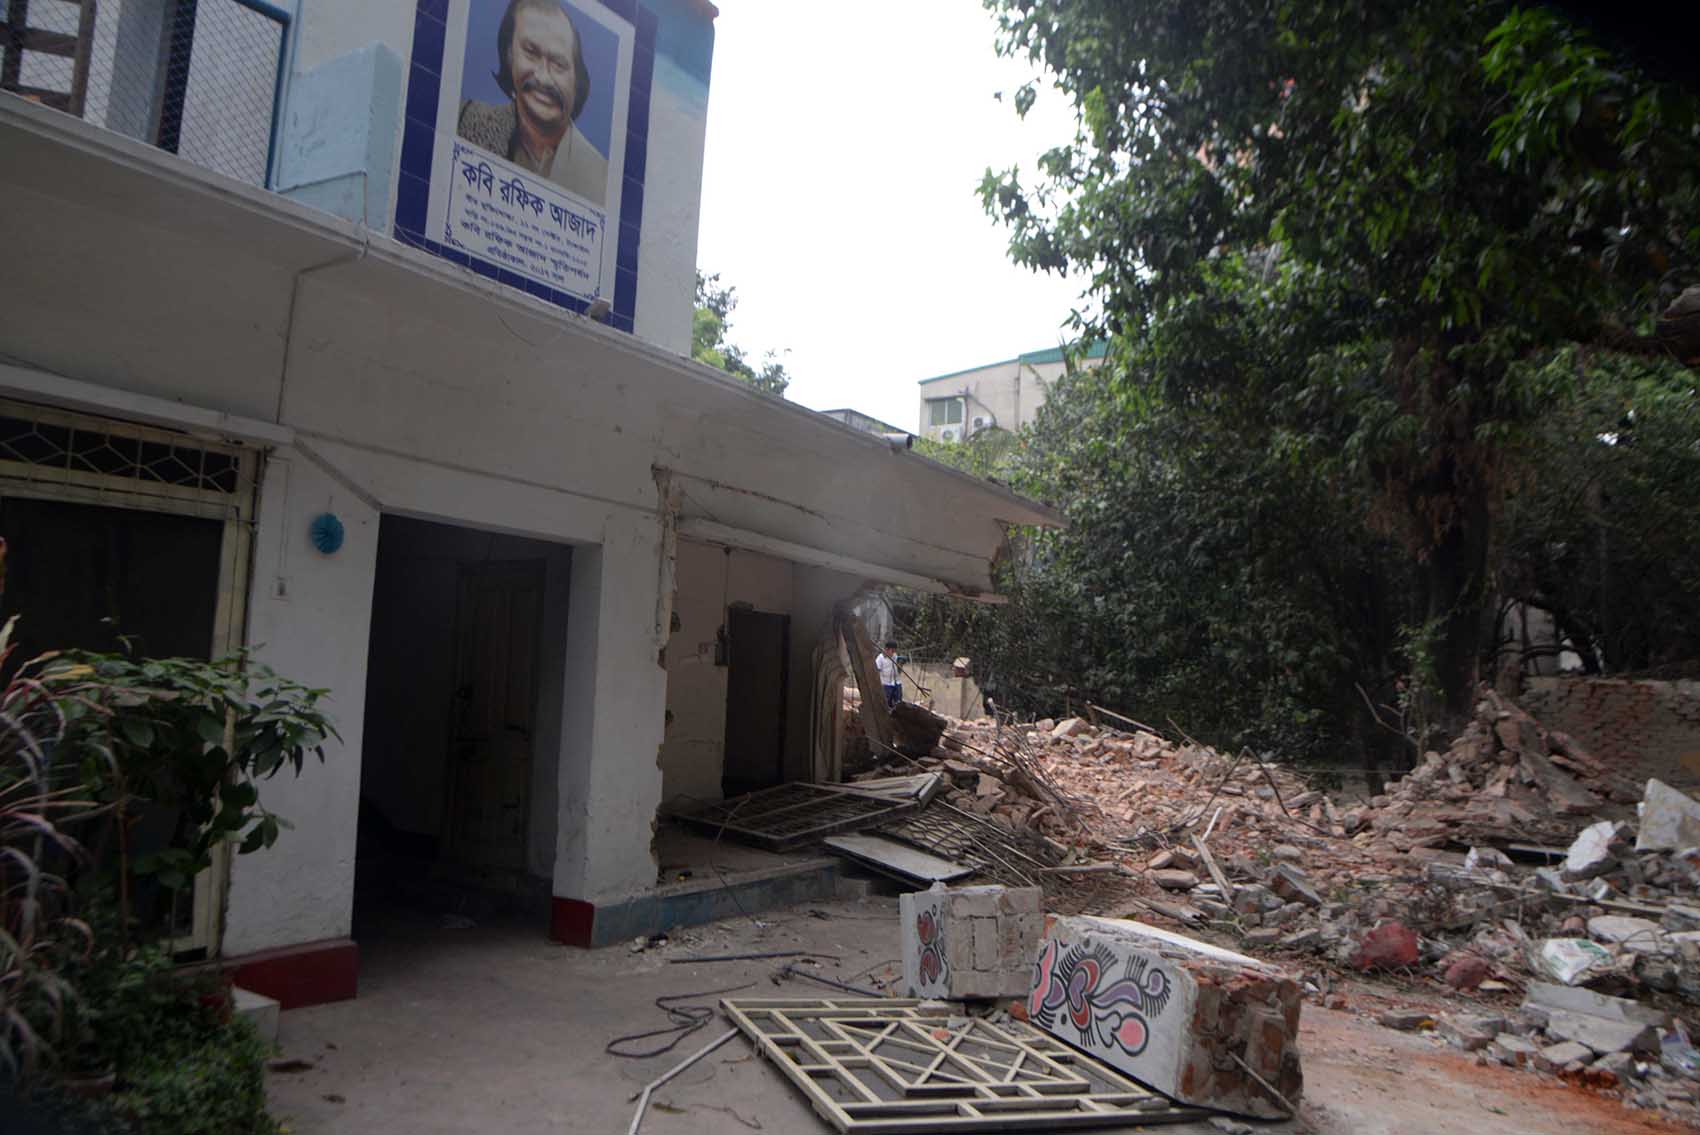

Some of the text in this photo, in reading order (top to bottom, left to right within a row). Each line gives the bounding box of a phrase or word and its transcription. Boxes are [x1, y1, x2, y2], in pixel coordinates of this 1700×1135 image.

[461, 161, 495, 198] কবি
[499, 178, 545, 217] রফিক
[549, 202, 598, 243] আজাদ
